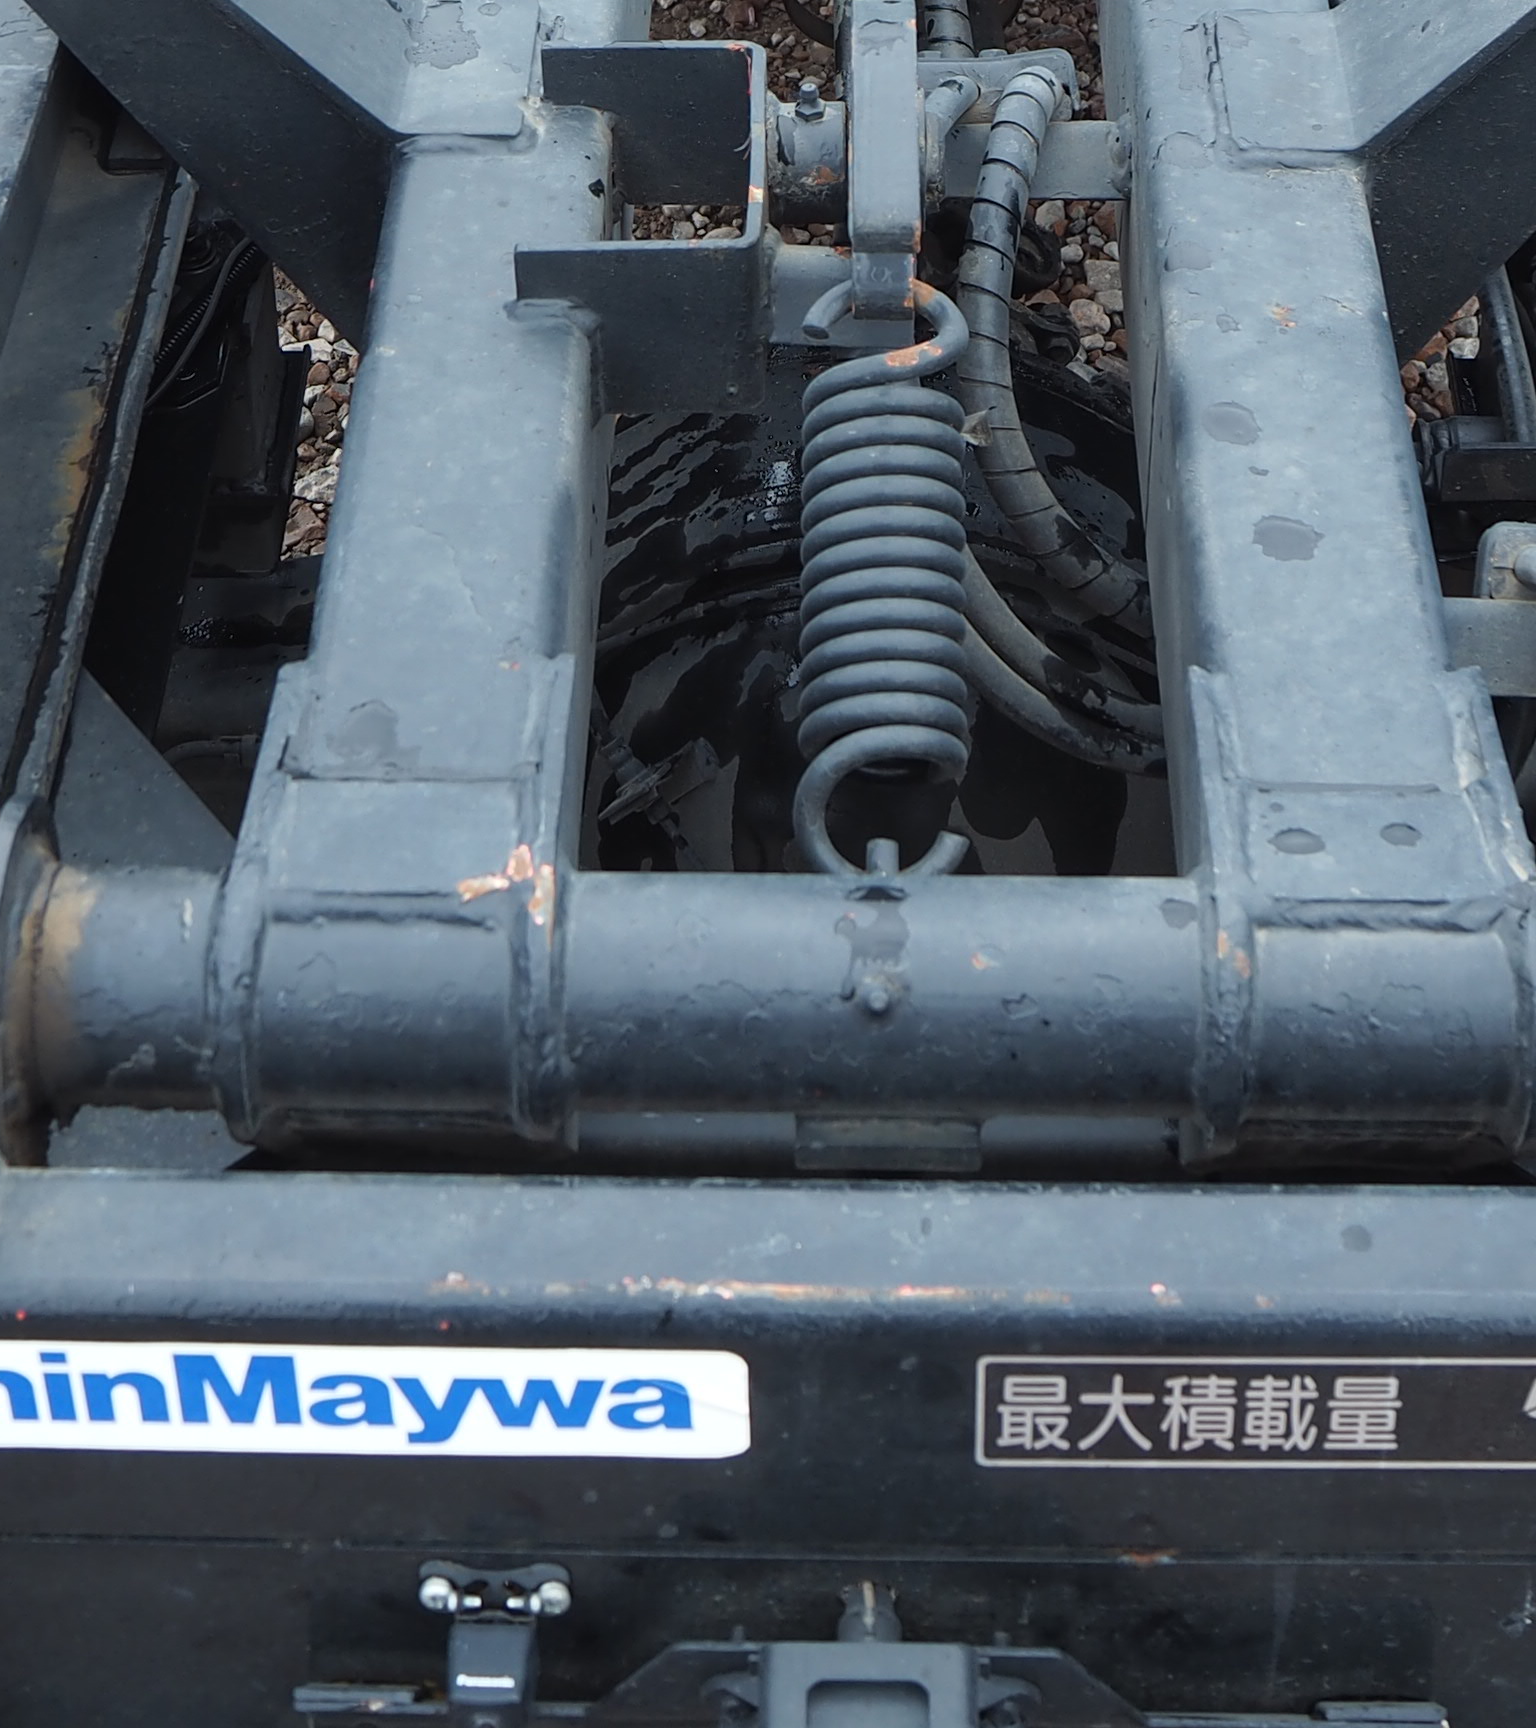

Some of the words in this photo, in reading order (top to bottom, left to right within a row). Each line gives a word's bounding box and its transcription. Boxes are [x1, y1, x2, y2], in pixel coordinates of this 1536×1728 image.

[995, 1374, 1403, 1452] 最大積載量
